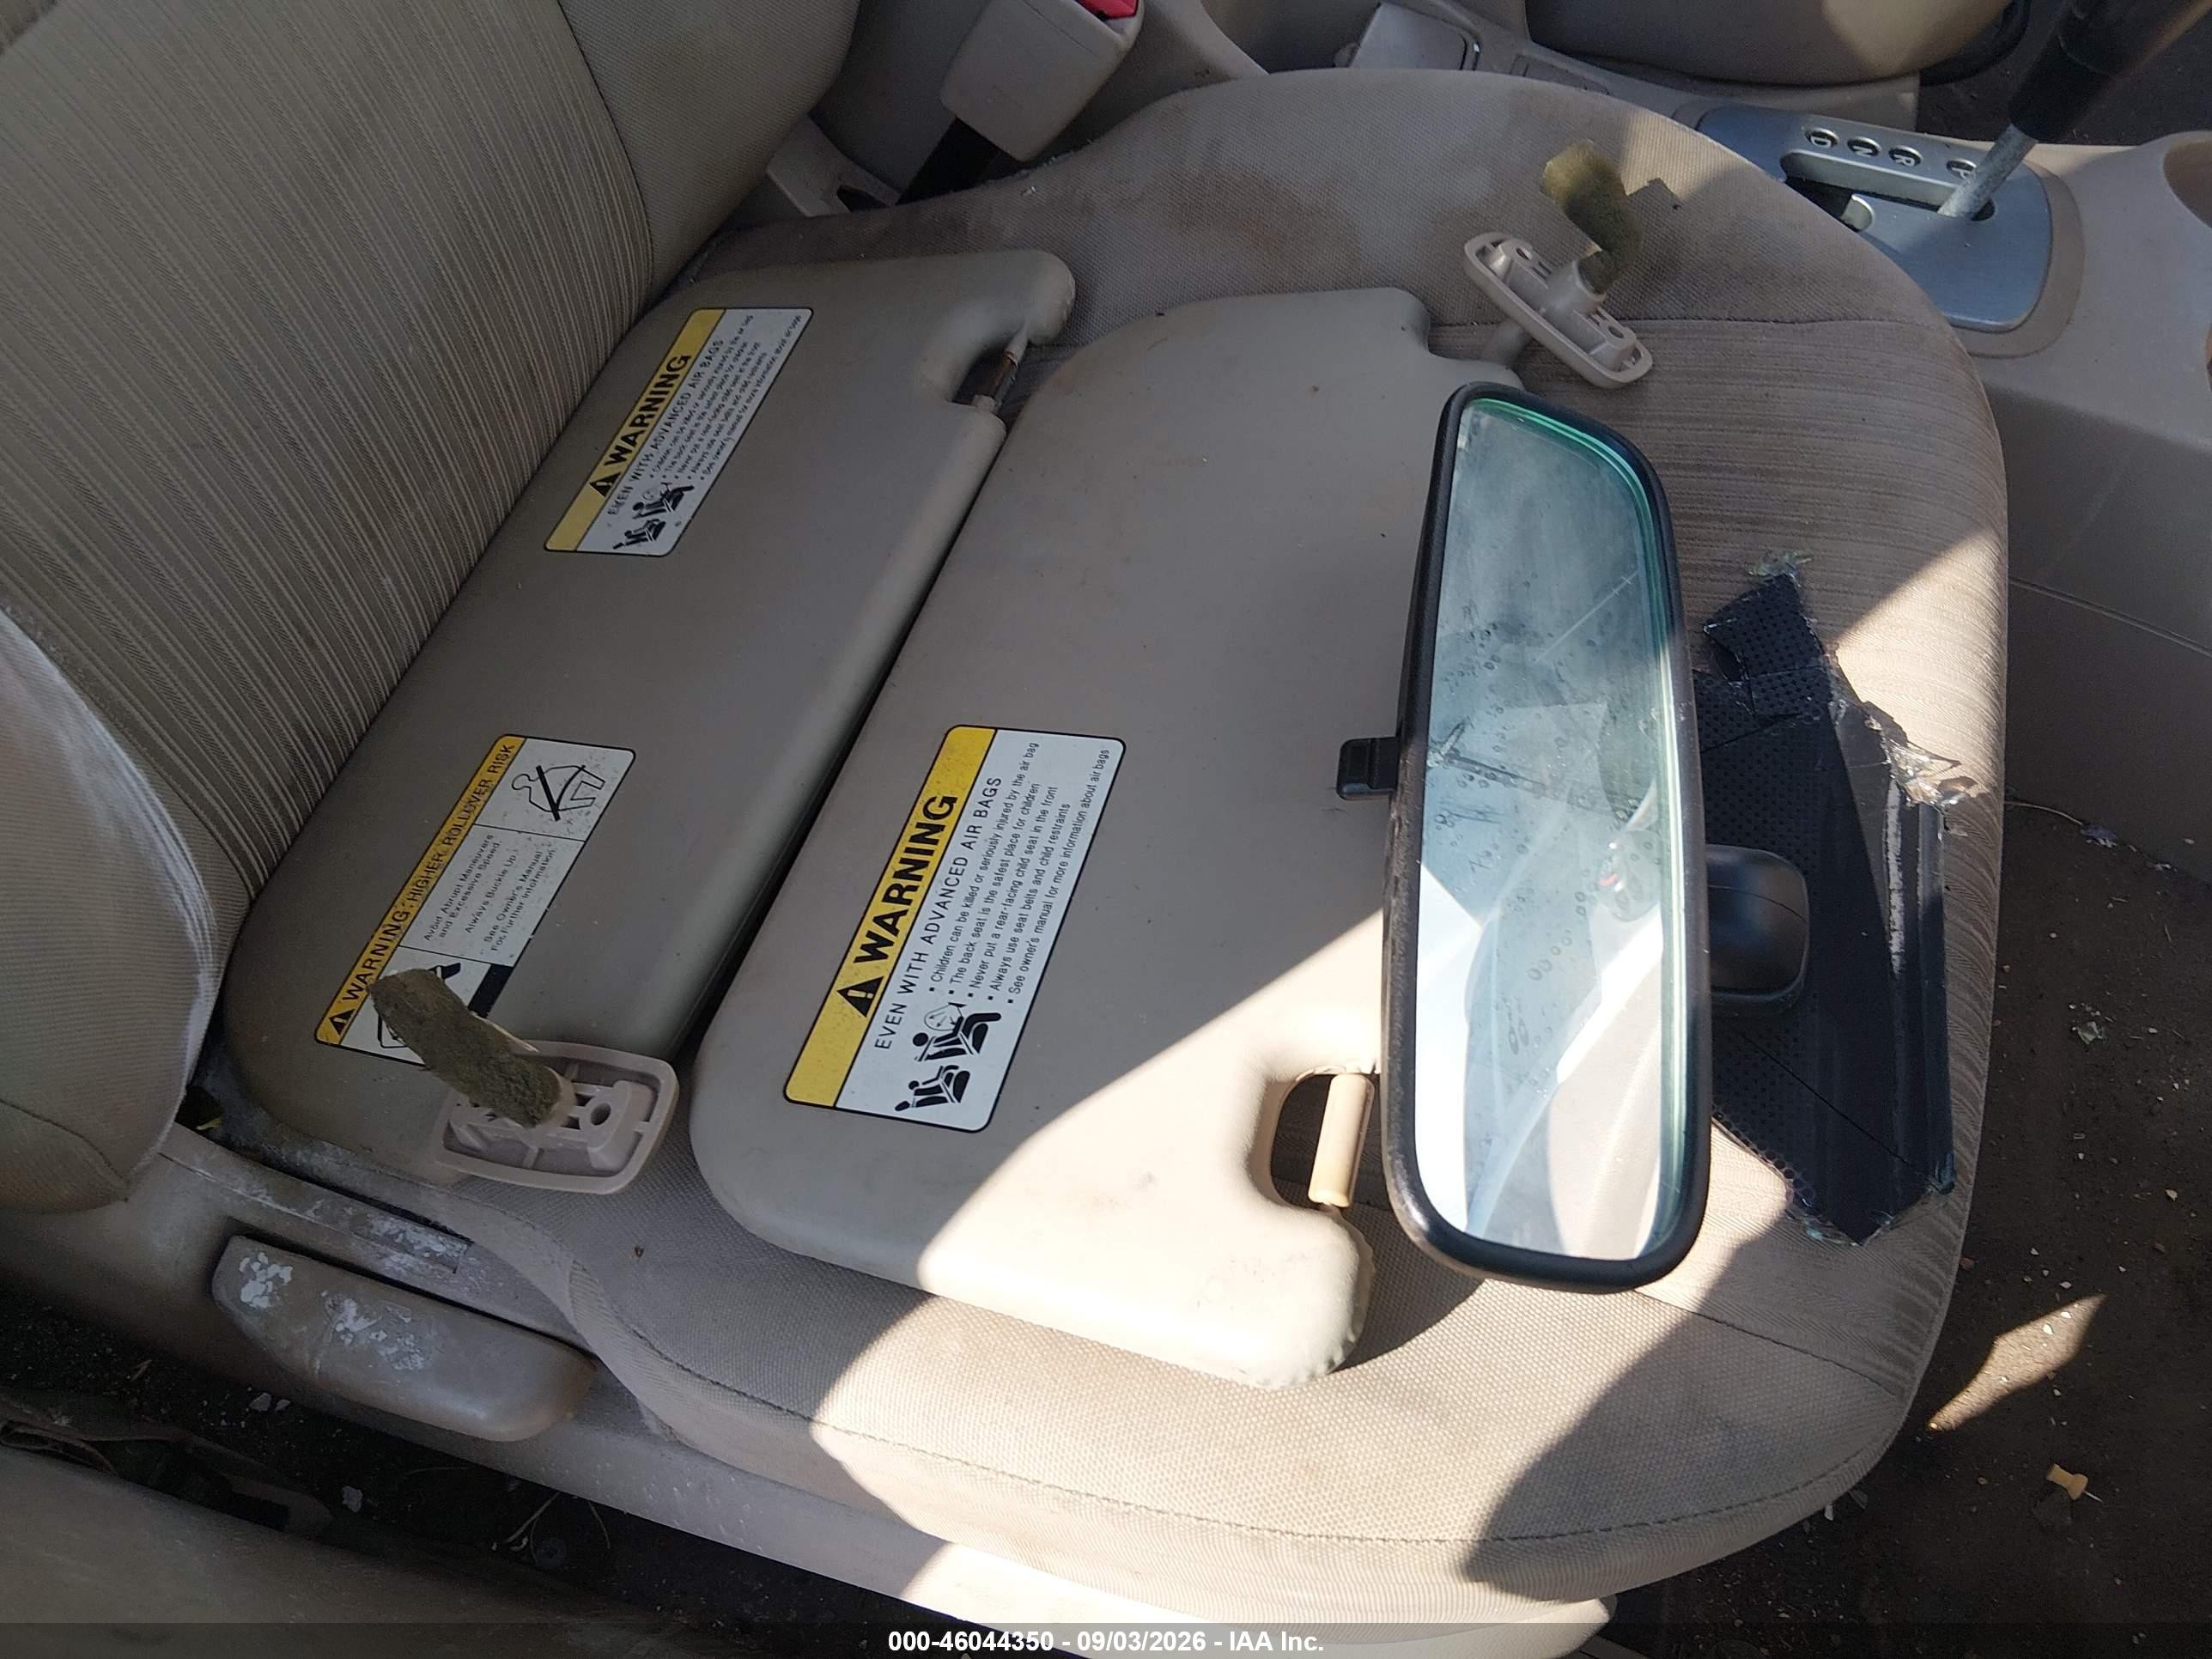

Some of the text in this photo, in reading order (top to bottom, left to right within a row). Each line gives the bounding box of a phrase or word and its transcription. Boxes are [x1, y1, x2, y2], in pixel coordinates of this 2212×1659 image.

[1810, 137, 1832, 149] D
[1852, 145, 1875, 158] N
[1893, 153, 1916, 167] R
[603, 354, 692, 466] WARNING
[606, 485, 634, 515] EVEN
[629, 453, 653, 481] WITH
[648, 392, 691, 450] ADVANCED
[687, 370, 705, 389] AIR
[698, 339, 724, 368] BAGS
[405, 852, 445, 902] HIGHER
[441, 778, 493, 846] ROLLOVER
[486, 744, 514, 774] RISK
[1031, 824, 1042, 833] in
[1034, 808, 1049, 823] the
[1039, 786, 1058, 806] front
[929, 741, 1040, 982] Children can be killed or seriously injured by the air bag
[1012, 749, 1109, 994] See owner's manual for more information about air bags
[1014, 856, 1030, 878] child
[1023, 835, 1039, 854] seat
[422, 834, 494, 941] Avoid Abrupt Maneuvers
[438, 920, 453, 938] and
[447, 872, 482, 918] Excessive
[464, 899, 489, 933] Always
[483, 868, 508, 898] Buckle
[483, 850, 544, 942] See Owner's Manual
[852, 794, 958, 963] WARNING
[948, 782, 1040, 983] The back seat is the safest place for children
[988, 803, 1071, 991] Always use seat belts and child restraints
[994, 878, 1024, 930] rear-facing
[500, 901, 525, 934] Further
[873, 777, 1002, 1049] EVEN WITH ADVANCED AIR BAGS
[968, 959, 989, 988] Never
[982, 941, 997, 957] put
